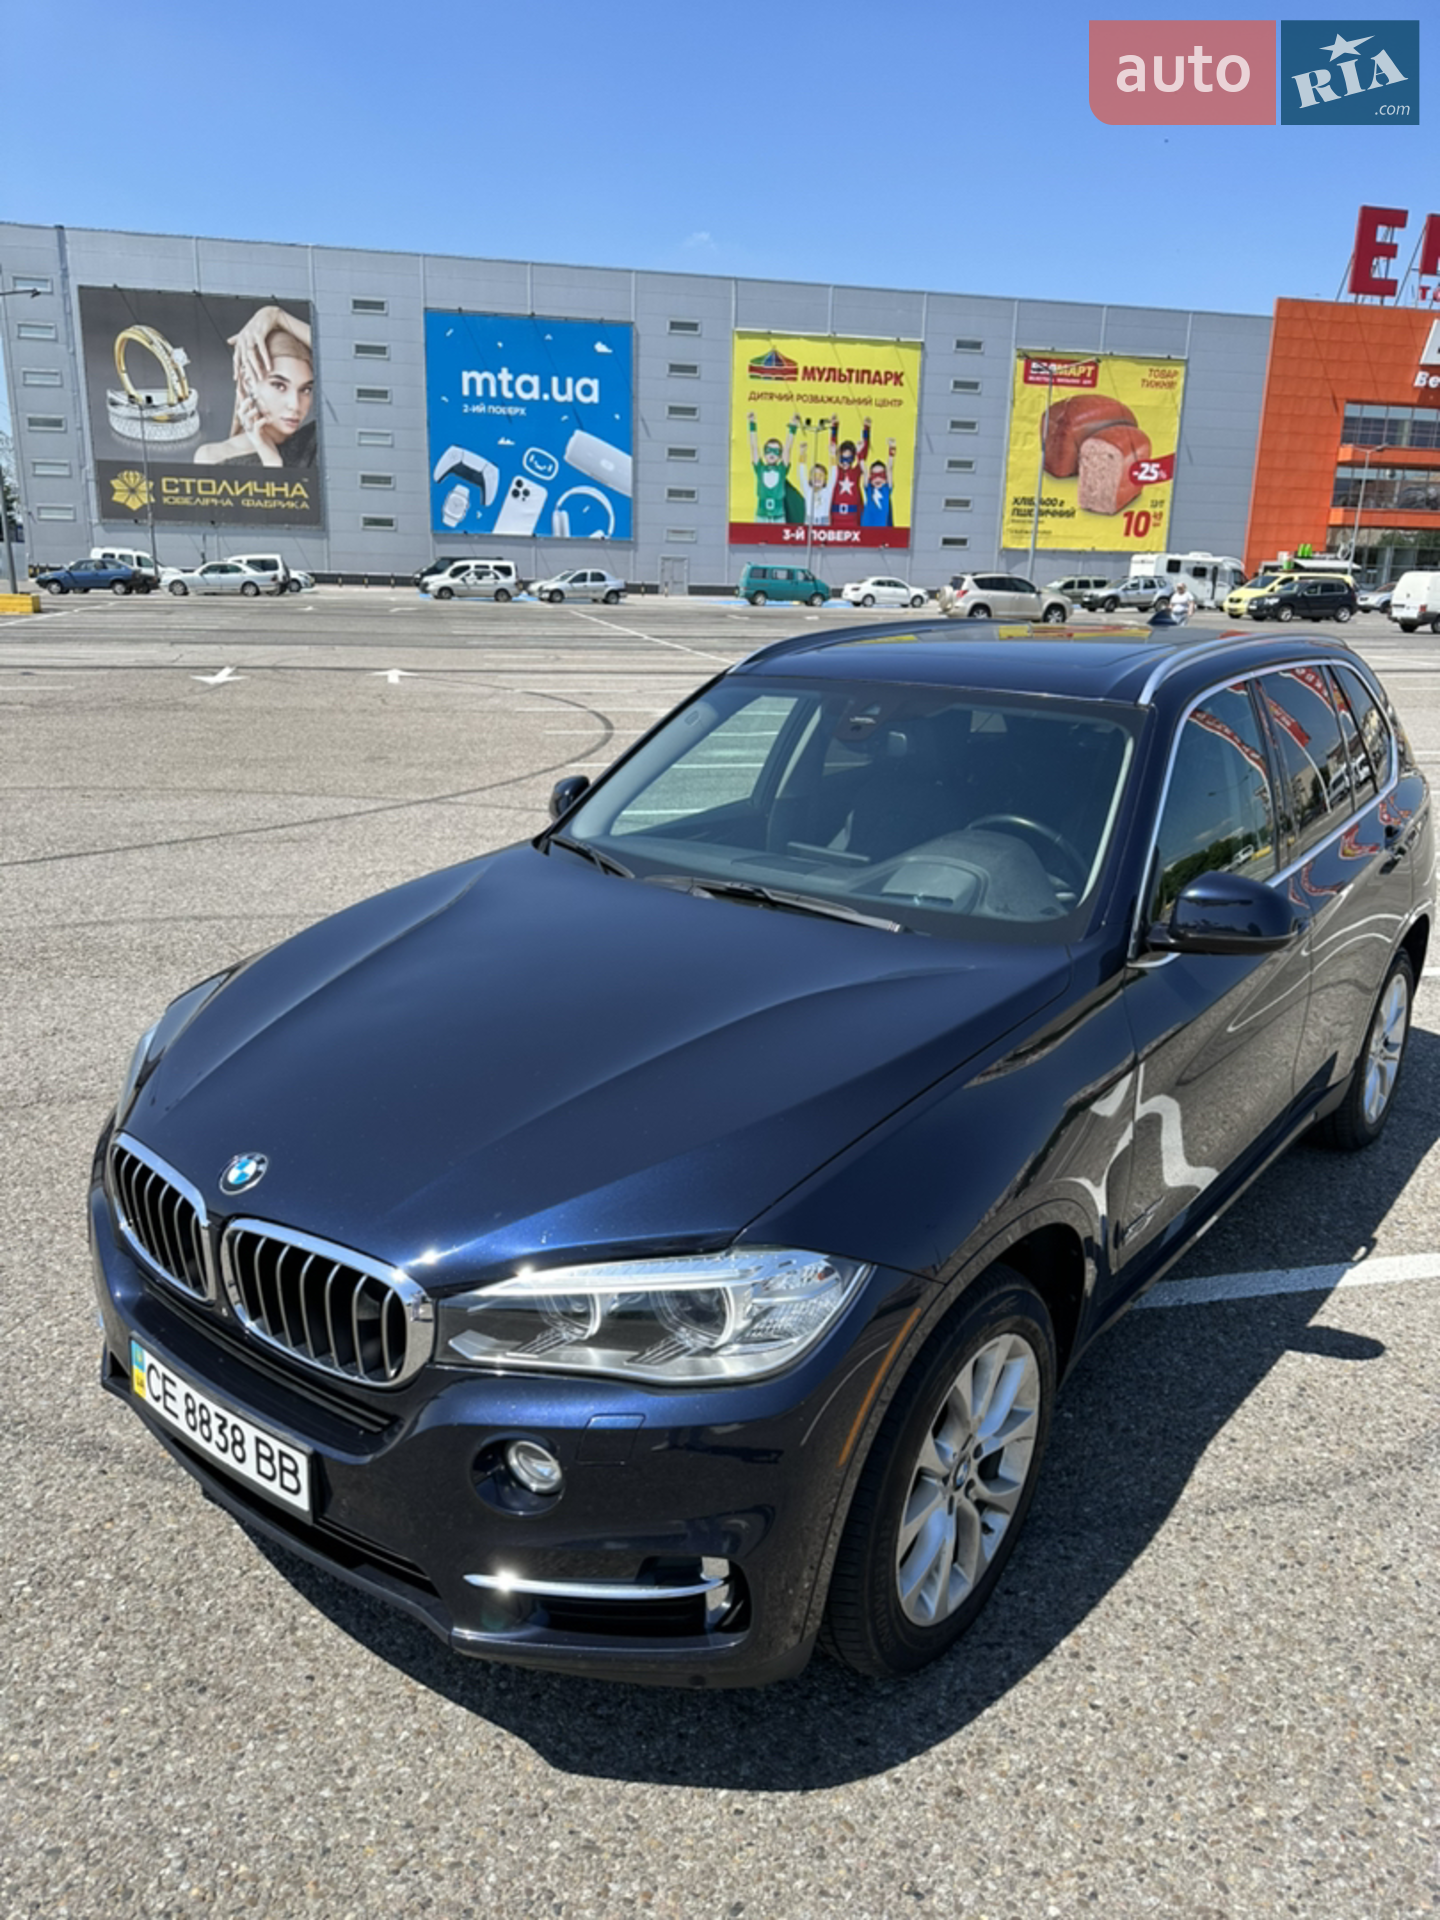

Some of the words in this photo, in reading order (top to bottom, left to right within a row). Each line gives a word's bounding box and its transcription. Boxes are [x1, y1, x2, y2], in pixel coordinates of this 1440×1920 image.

[461, 366, 600, 405] mta.ua
[801, 366, 904, 387] МУЛЬТІПАРК
[748, 391, 795, 403] ДИТЯЧИЙ
[796, 393, 873, 407] РОЗВАЖАЛЬНИЙ
[875, 397, 904, 409] ЦЕНТР
[487, 404, 527, 417] ПОВЕРХ
[161, 476, 309, 499] СТОЛИЧНА
[162, 495, 234, 508] ЮВЕЛІРНА
[241, 498, 310, 511] ФАБРИКА
[1011, 506, 1076, 518] ПШЕИЧНИЙ
[1123, 509, 1151, 539] 10
[810, 529, 861, 542] ПОВЕРХ
[147, 1362, 179, 1420] CE
[184, 1391, 247, 1465] 8838
[255, 1435, 302, 1497] BB
